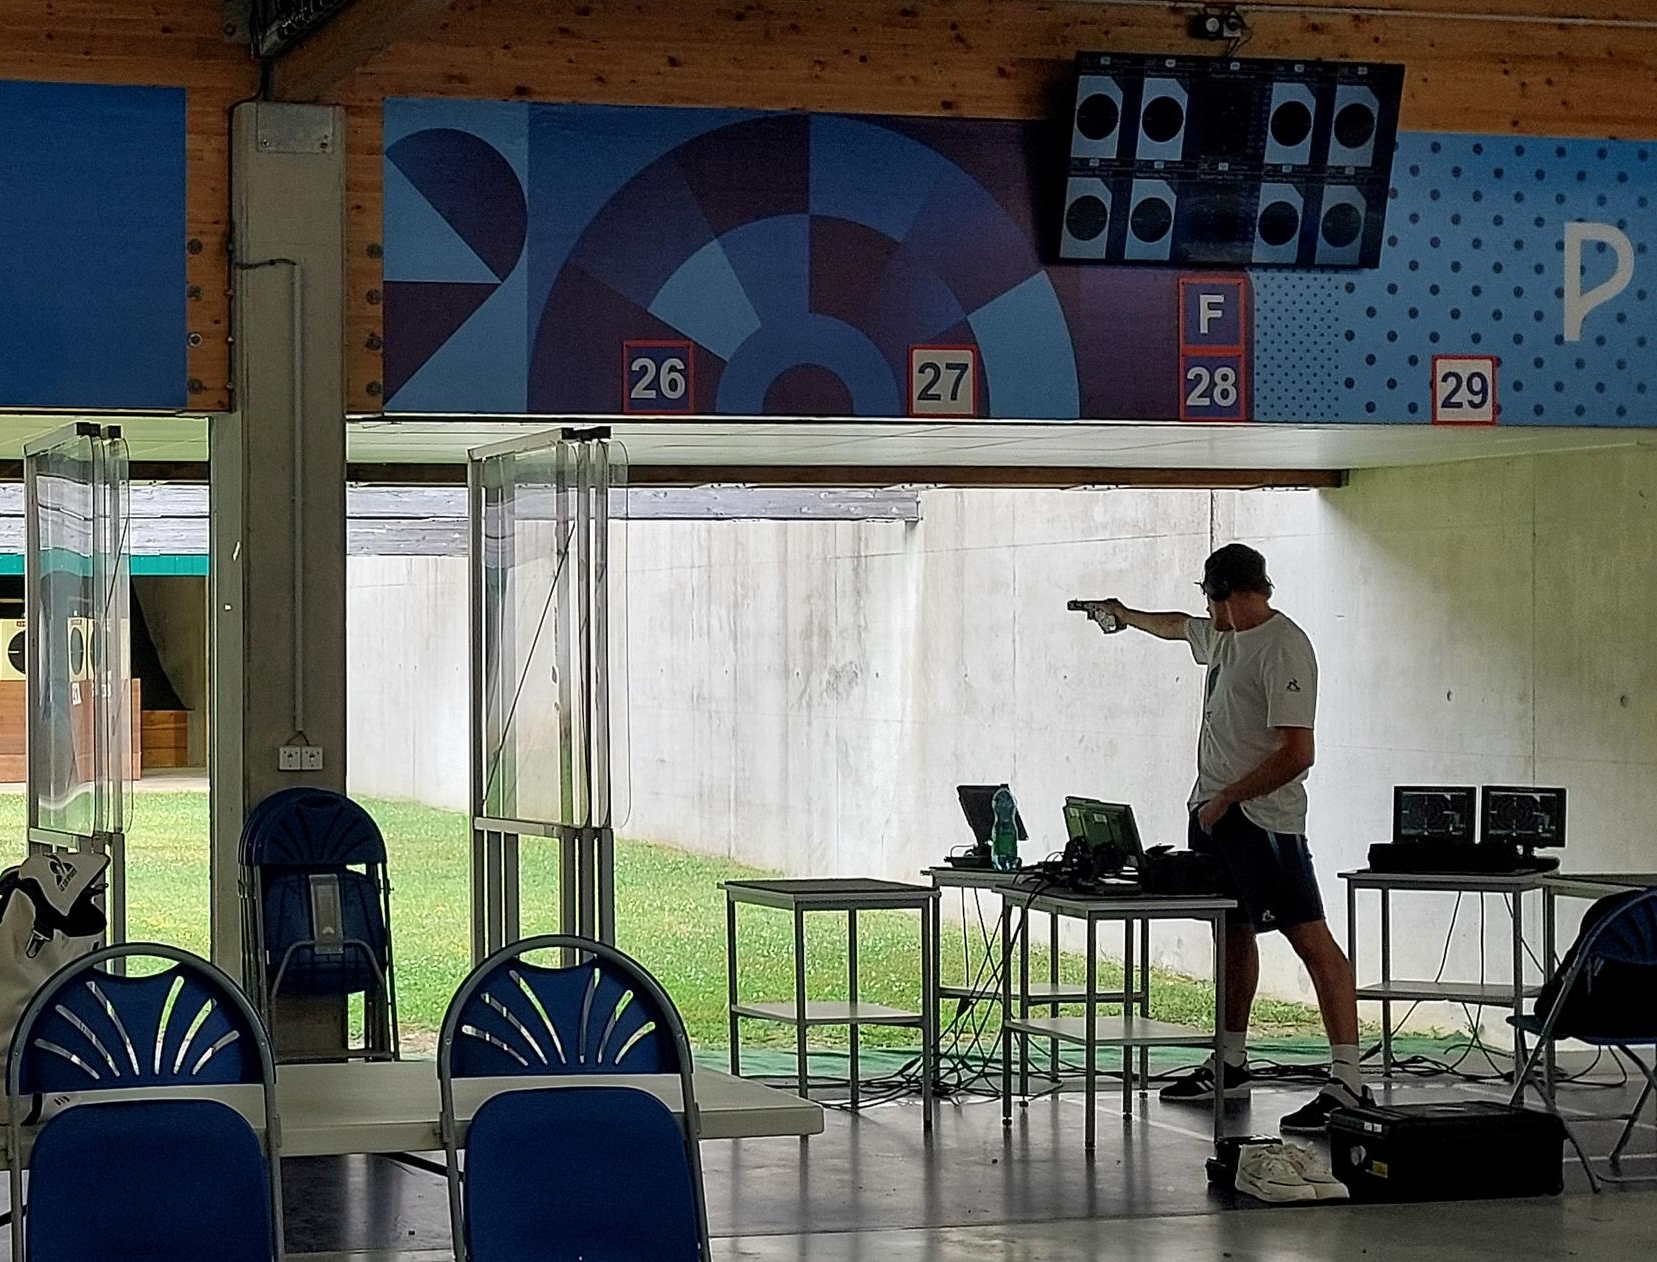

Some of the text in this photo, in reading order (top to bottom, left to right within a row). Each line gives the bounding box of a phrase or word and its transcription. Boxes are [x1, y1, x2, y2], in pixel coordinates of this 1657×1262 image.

[1564, 222, 1635, 342] P
[1200, 294, 1225, 334] F
[630, 357, 686, 399] 26
[917, 361, 969, 401] 27
[1186, 366, 1237, 407] 28
[1441, 371, 1489, 410] 29
